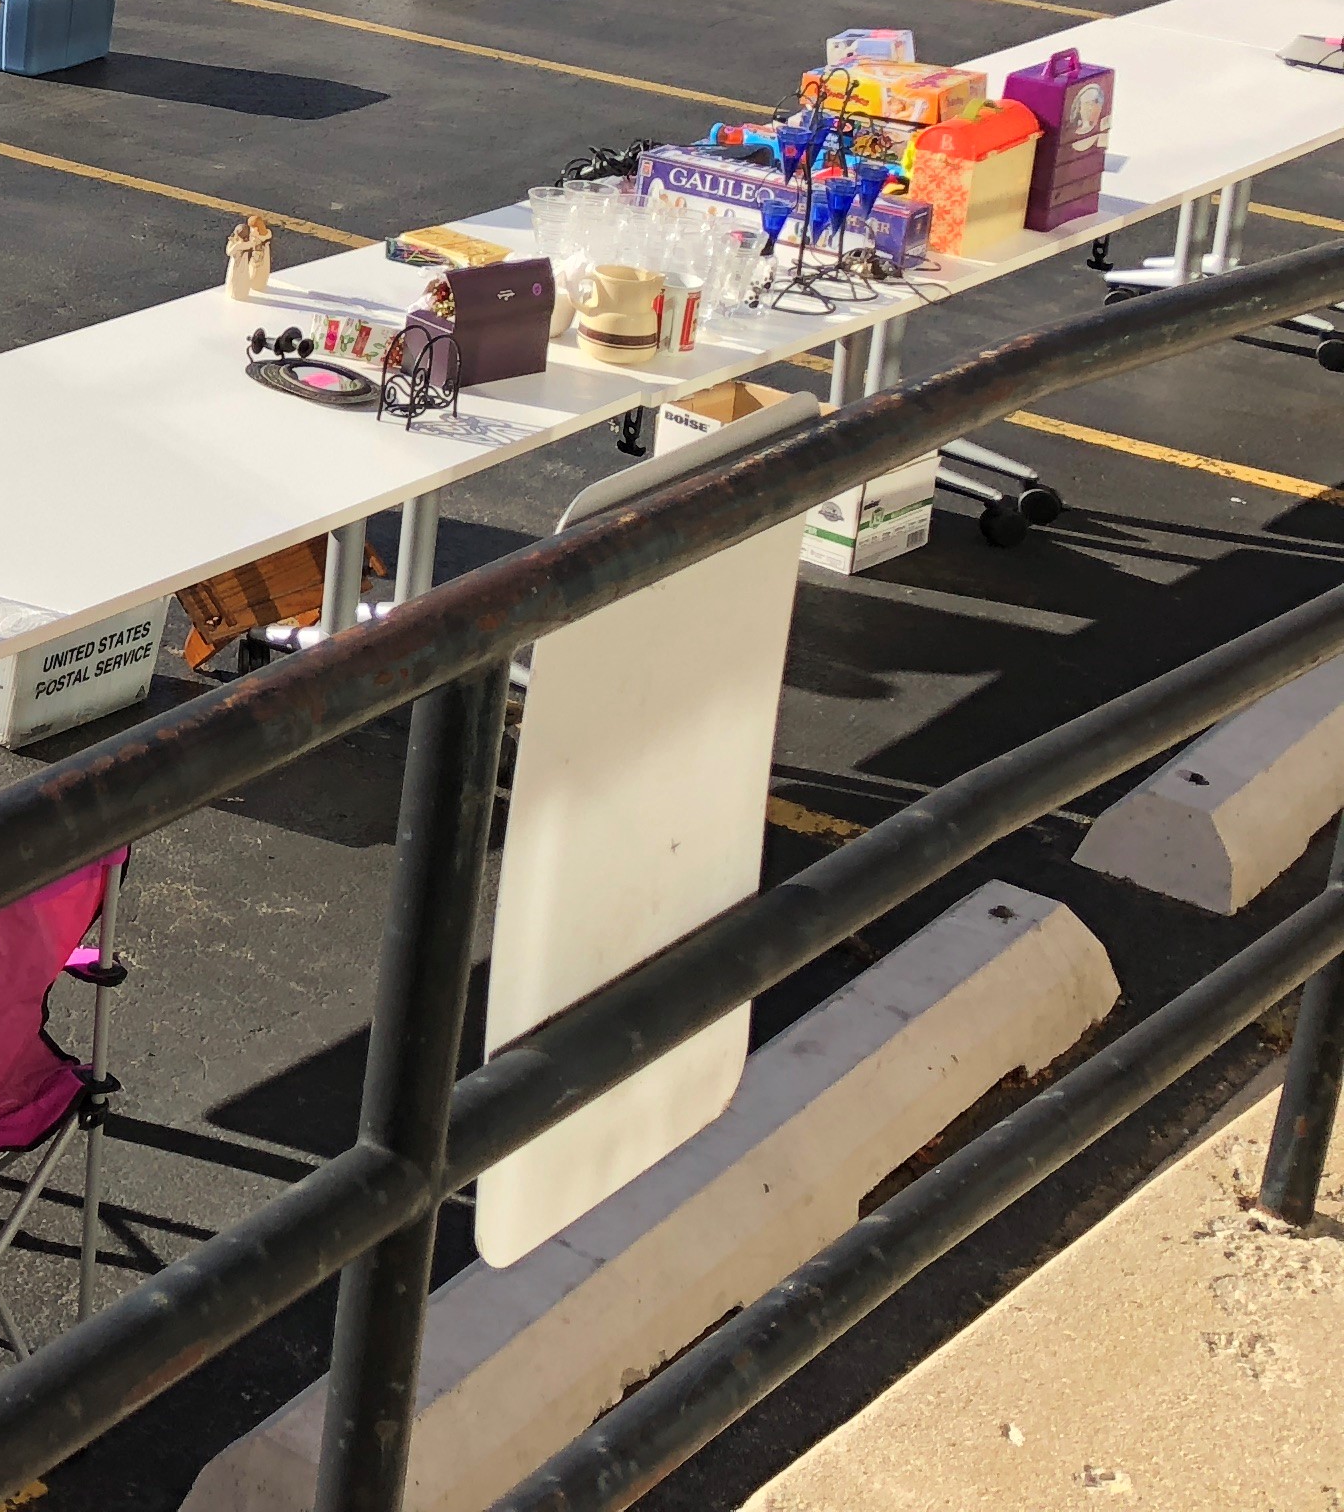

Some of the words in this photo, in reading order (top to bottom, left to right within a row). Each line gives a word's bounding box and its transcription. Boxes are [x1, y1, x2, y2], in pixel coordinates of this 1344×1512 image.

[668, 167, 775, 202] GALILEO
[35, 667, 91, 700] POSTAL
[94, 641, 154, 679] SERVICE
[42, 641, 95, 673] UNITED
[97, 620, 152, 654] STATES
